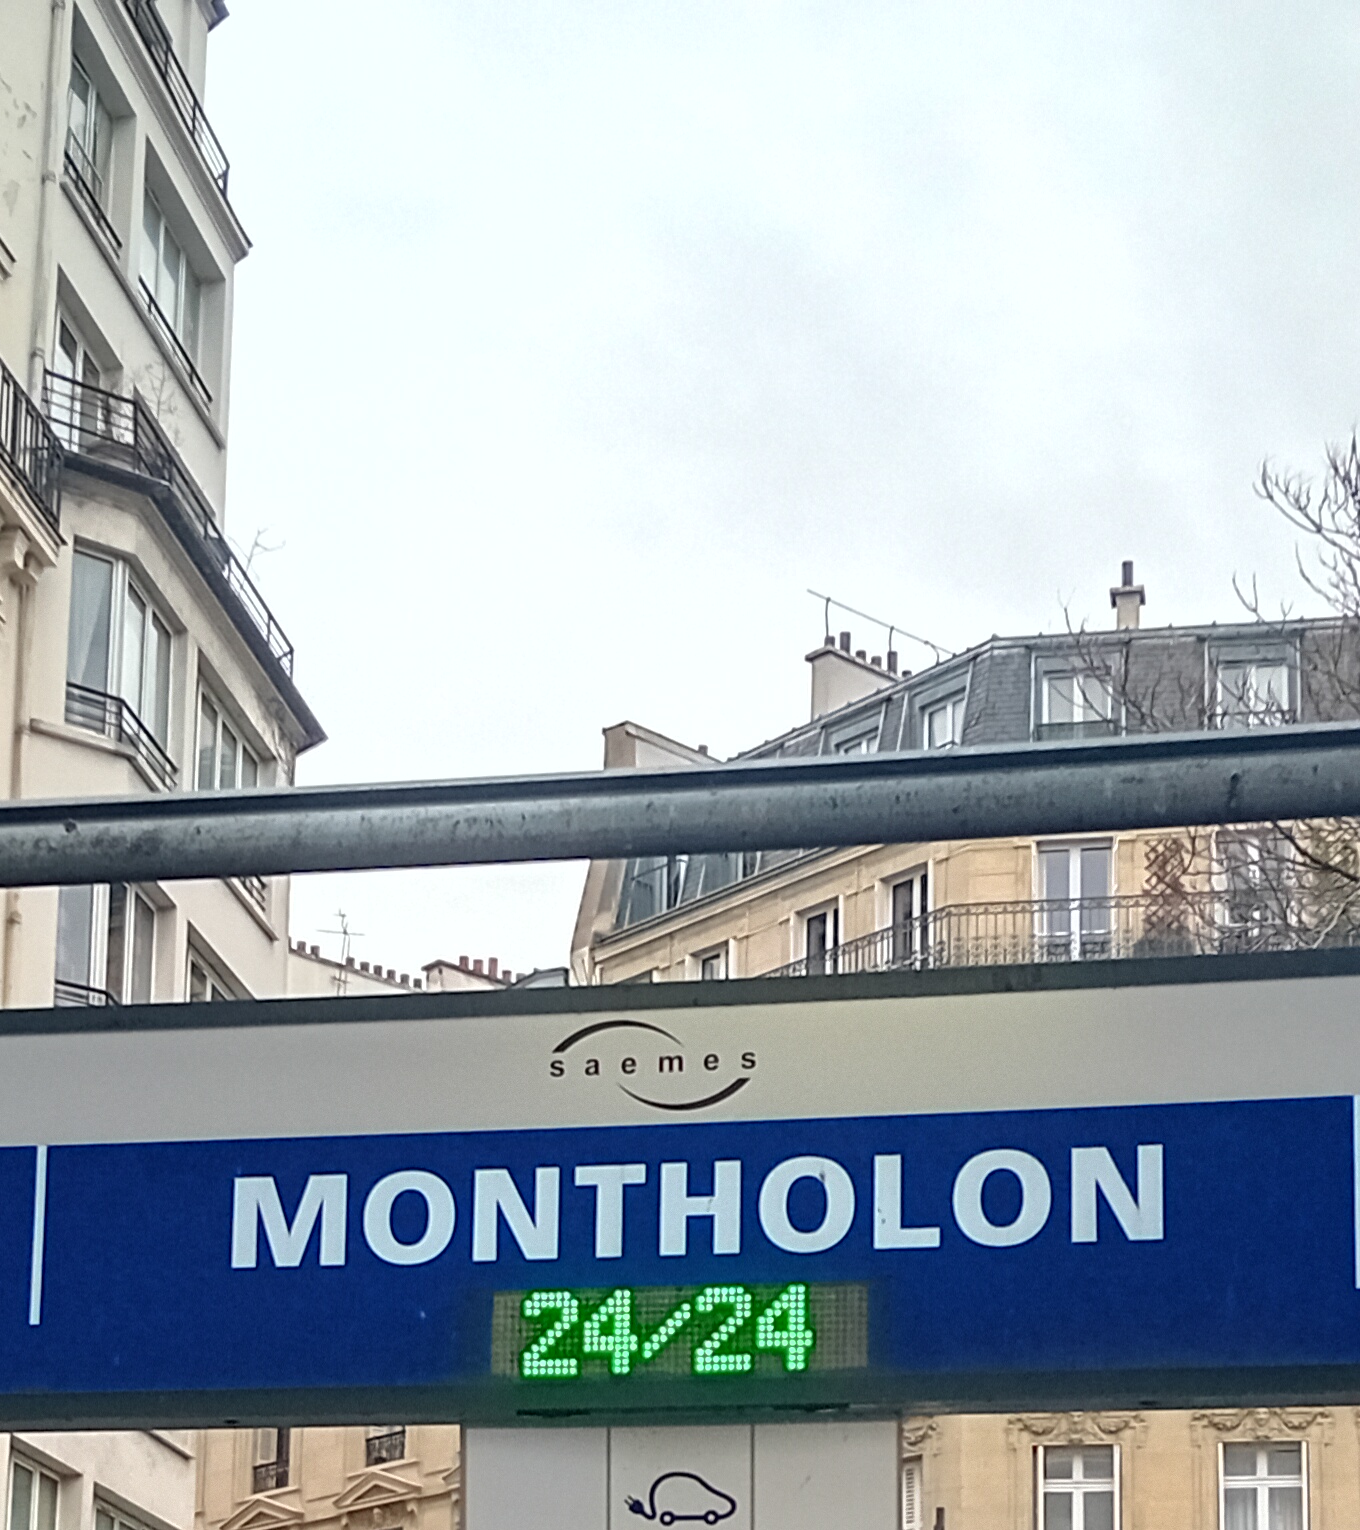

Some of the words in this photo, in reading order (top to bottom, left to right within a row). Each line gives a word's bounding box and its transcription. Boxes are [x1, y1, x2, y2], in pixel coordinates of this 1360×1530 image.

[549, 1051, 757, 1078] saemes
[230, 1143, 1165, 1270] MONTHOLON
[521, 1284, 815, 1377] 24/24
